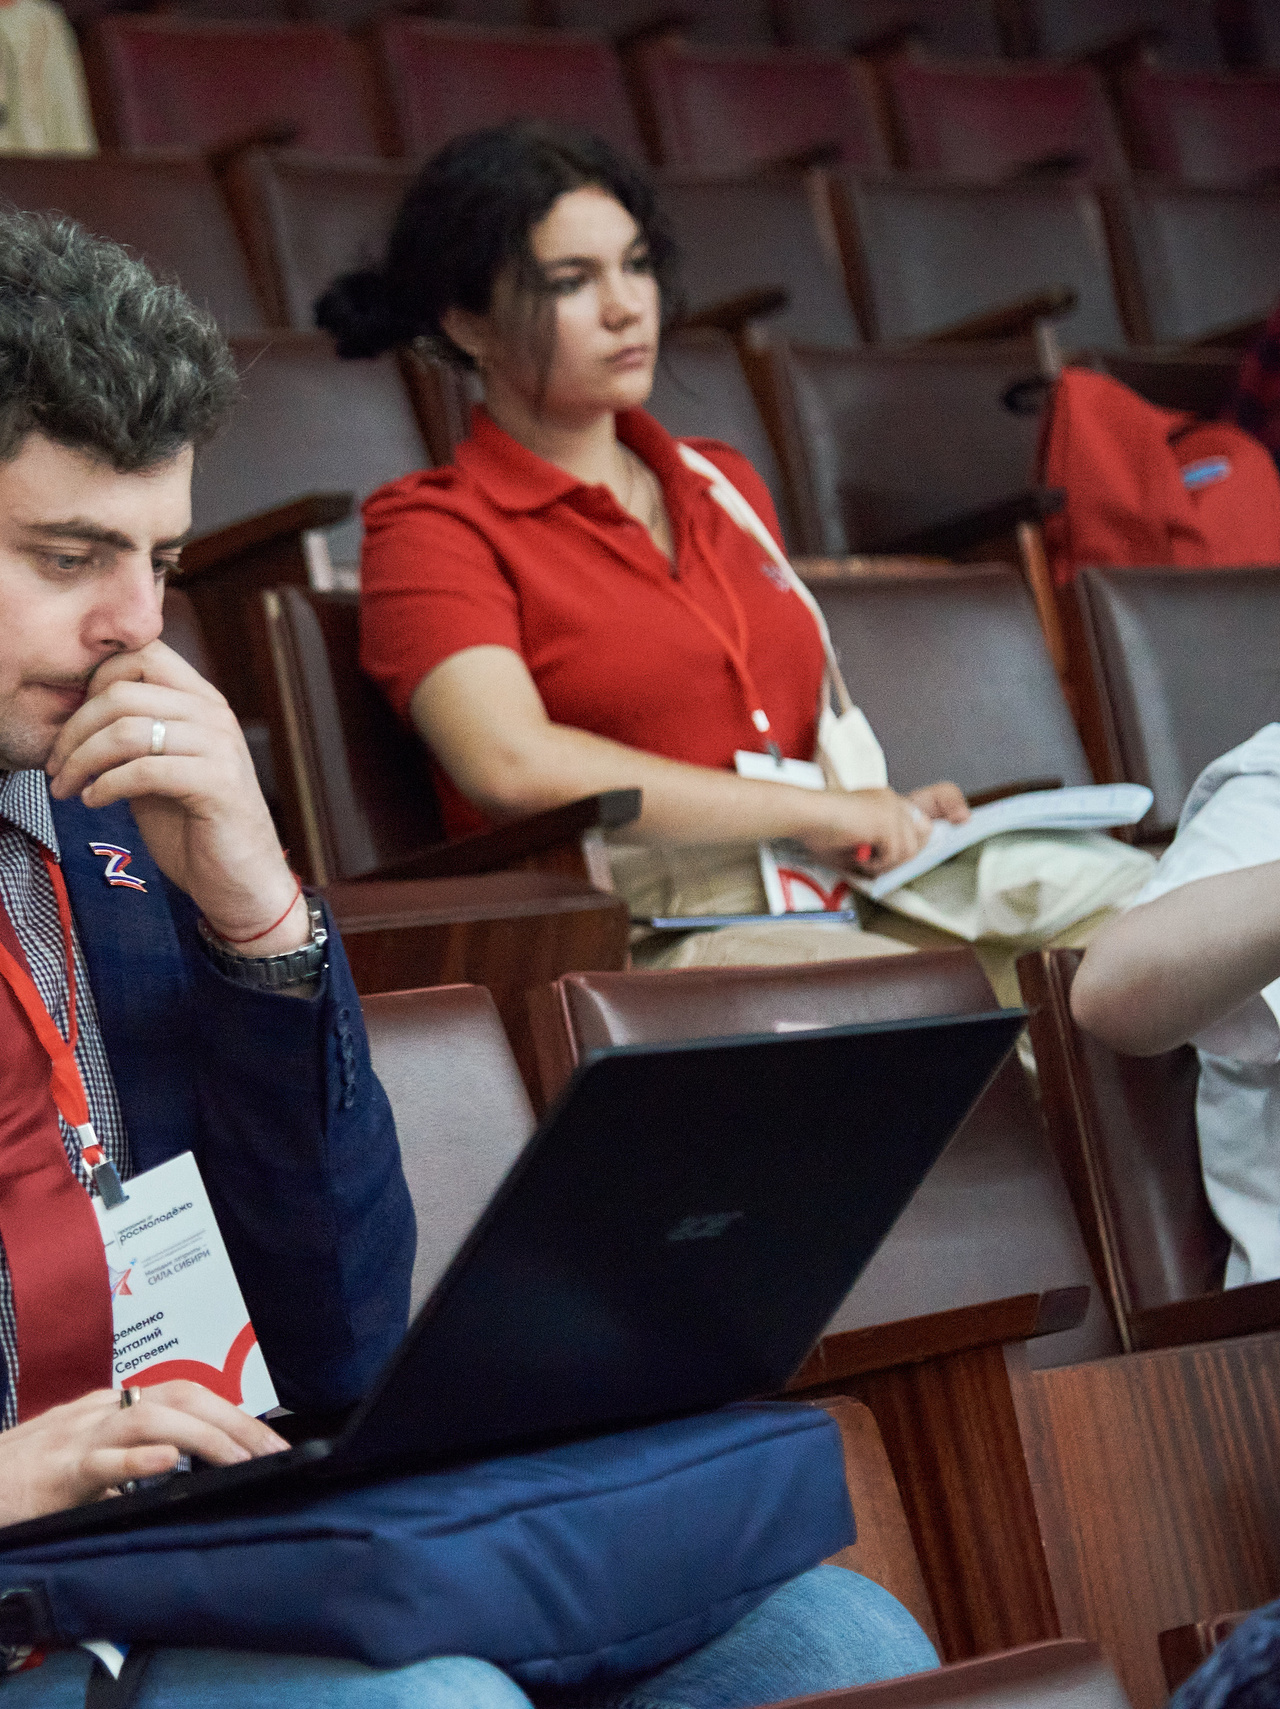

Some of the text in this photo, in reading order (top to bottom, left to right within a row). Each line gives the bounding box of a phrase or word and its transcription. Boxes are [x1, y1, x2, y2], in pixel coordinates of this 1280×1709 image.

[147, 1267, 173, 1286] СИЛА
[173, 1248, 210, 1272] СИБИРИ
[113, 1311, 163, 1344] ременко
[115, 1338, 178, 1373] Сергеевич
